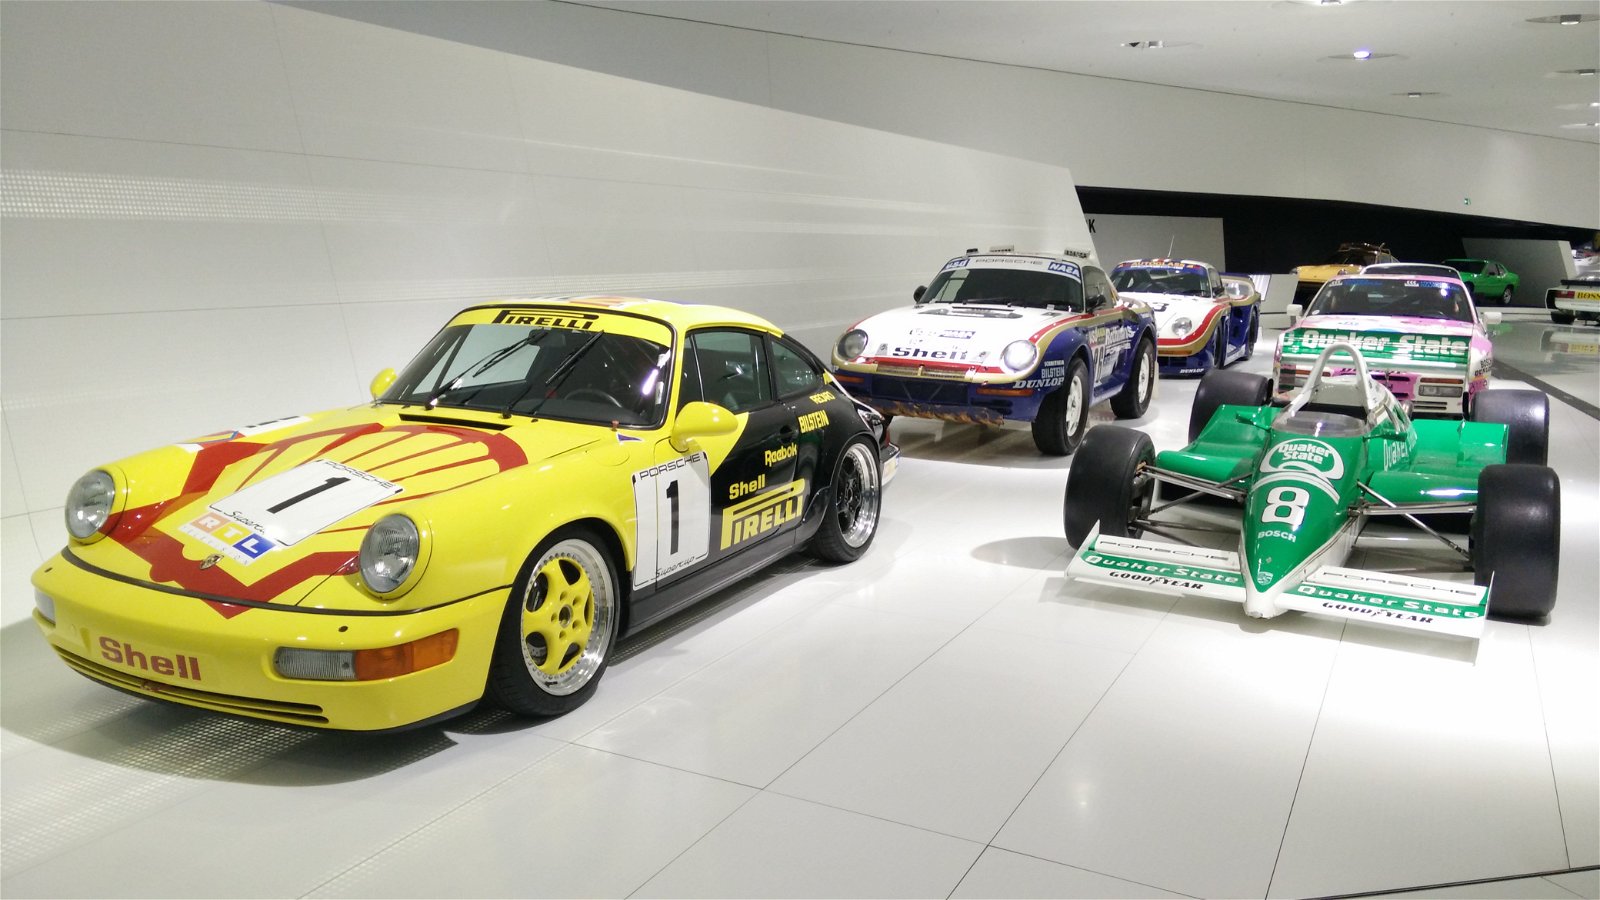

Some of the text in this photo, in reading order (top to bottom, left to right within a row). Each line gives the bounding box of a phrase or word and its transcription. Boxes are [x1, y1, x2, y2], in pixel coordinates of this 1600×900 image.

[1086, 218, 1096, 233] K
[975, 258, 1043, 266] PORSCHE
[1050, 262, 1080, 277] NASA
[492, 309, 599, 330] PIRELLI
[892, 347, 968, 360] Shell
[1303, 329, 1468, 355] Quaker State
[1012, 377, 1065, 389] DUNLOP
[1041, 366, 1065, 379] BILSTEIN
[798, 409, 829, 434] BILSTEIN
[764, 442, 798, 467] Reebok
[1278, 443, 1330, 458] Quaker
[1282, 451, 1324, 464] State
[325, 460, 396, 490] PORSCHE
[639, 451, 701, 480] PORSCHE
[266, 476, 351, 515] 1
[729, 473, 766, 500] Shell
[666, 479, 679, 556] 1
[720, 478, 806, 551] PIRELLI
[1261, 486, 1310, 526] 8
[194, 513, 269, 557] RTL
[1258, 531, 1297, 543] BOSCH
[1098, 540, 1230, 561] PORSCHE
[1084, 554, 1240, 584] Quaker State
[1322, 570, 1478, 597] PORSCHE
[1298, 584, 1480, 619] Quaker State
[99, 635, 202, 681] Shell
